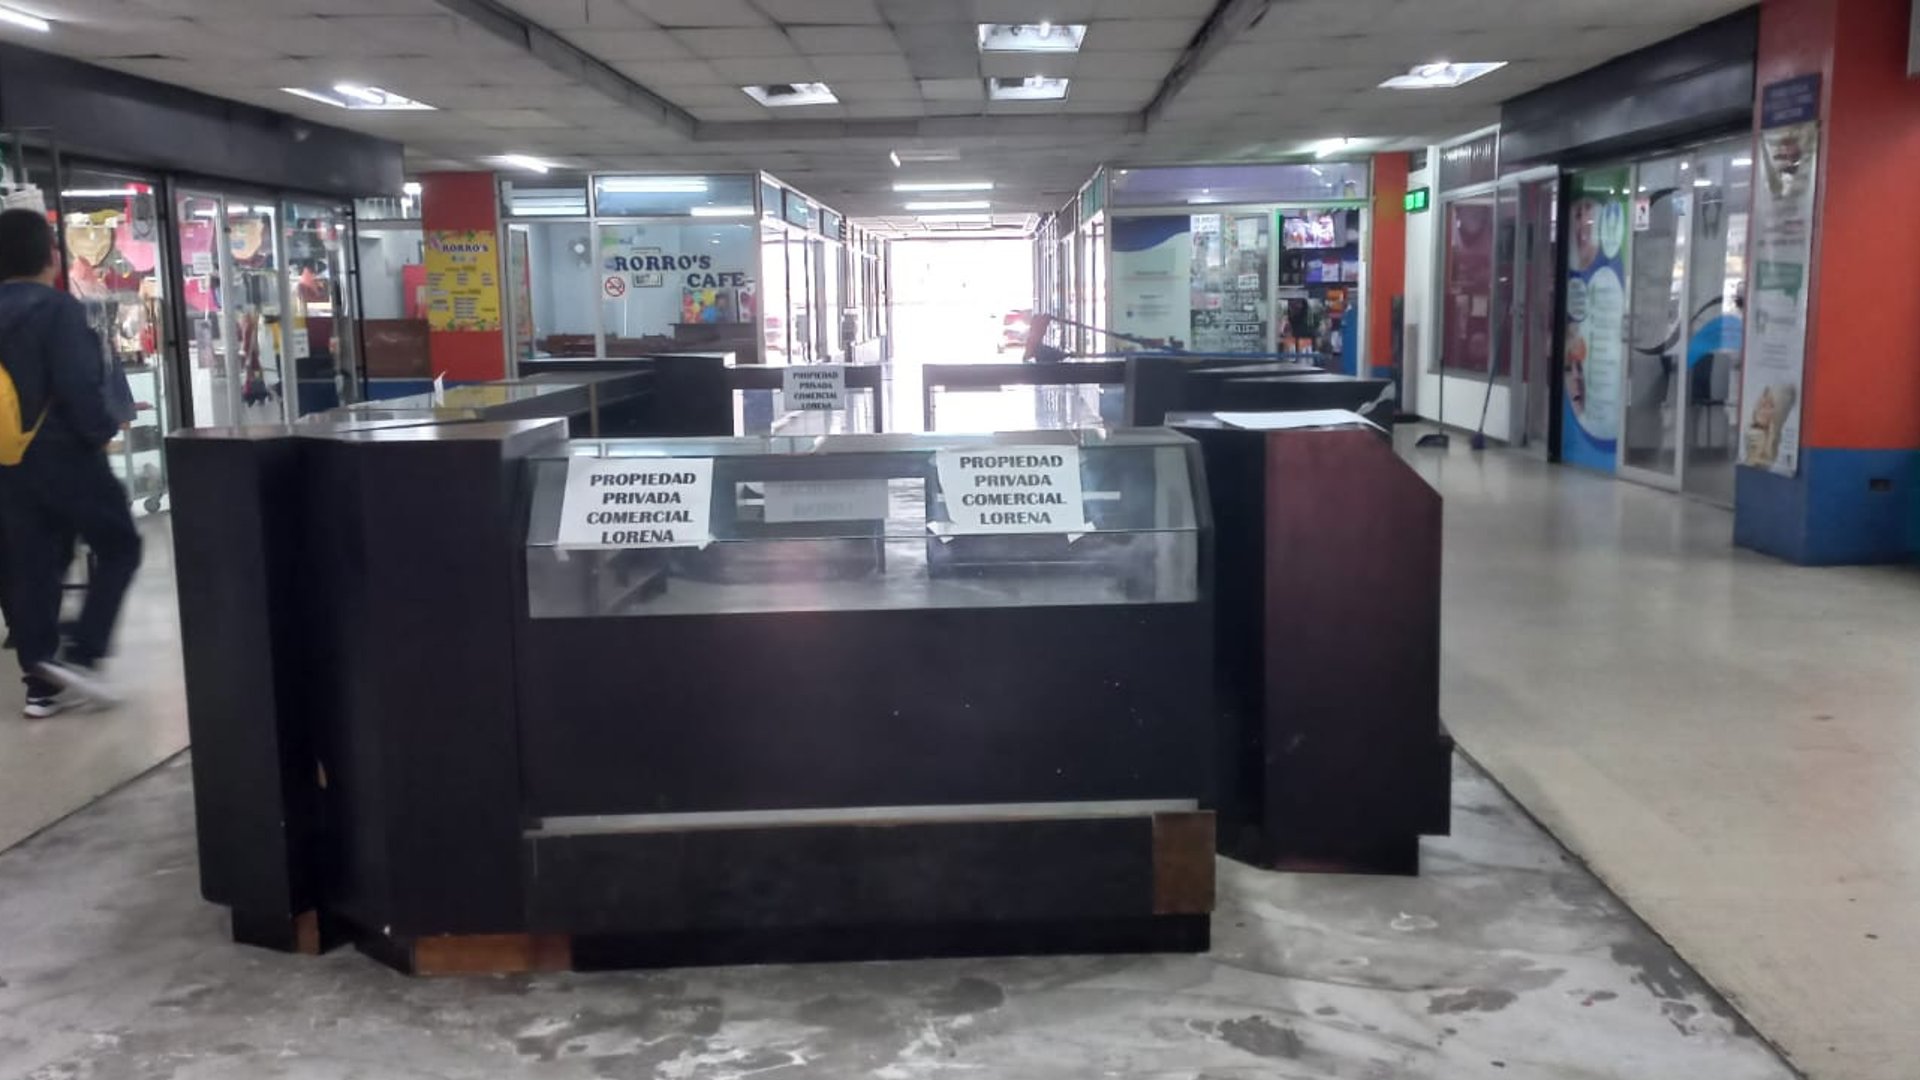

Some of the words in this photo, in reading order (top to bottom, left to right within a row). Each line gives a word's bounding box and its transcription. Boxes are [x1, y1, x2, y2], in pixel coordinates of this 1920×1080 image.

[614, 254, 712, 271] RORRO'S
[959, 455, 1064, 469] PROPIEDAD
[590, 473, 697, 487] PROPIEDAD
[974, 474, 1053, 487] PRIVADA
[602, 491, 682, 505] PRIVADA
[962, 492, 1067, 506] COMERCIAL
[586, 510, 695, 525] COMERCIAL
[980, 511, 1053, 526] LORENA
[601, 529, 675, 545] LORENA
